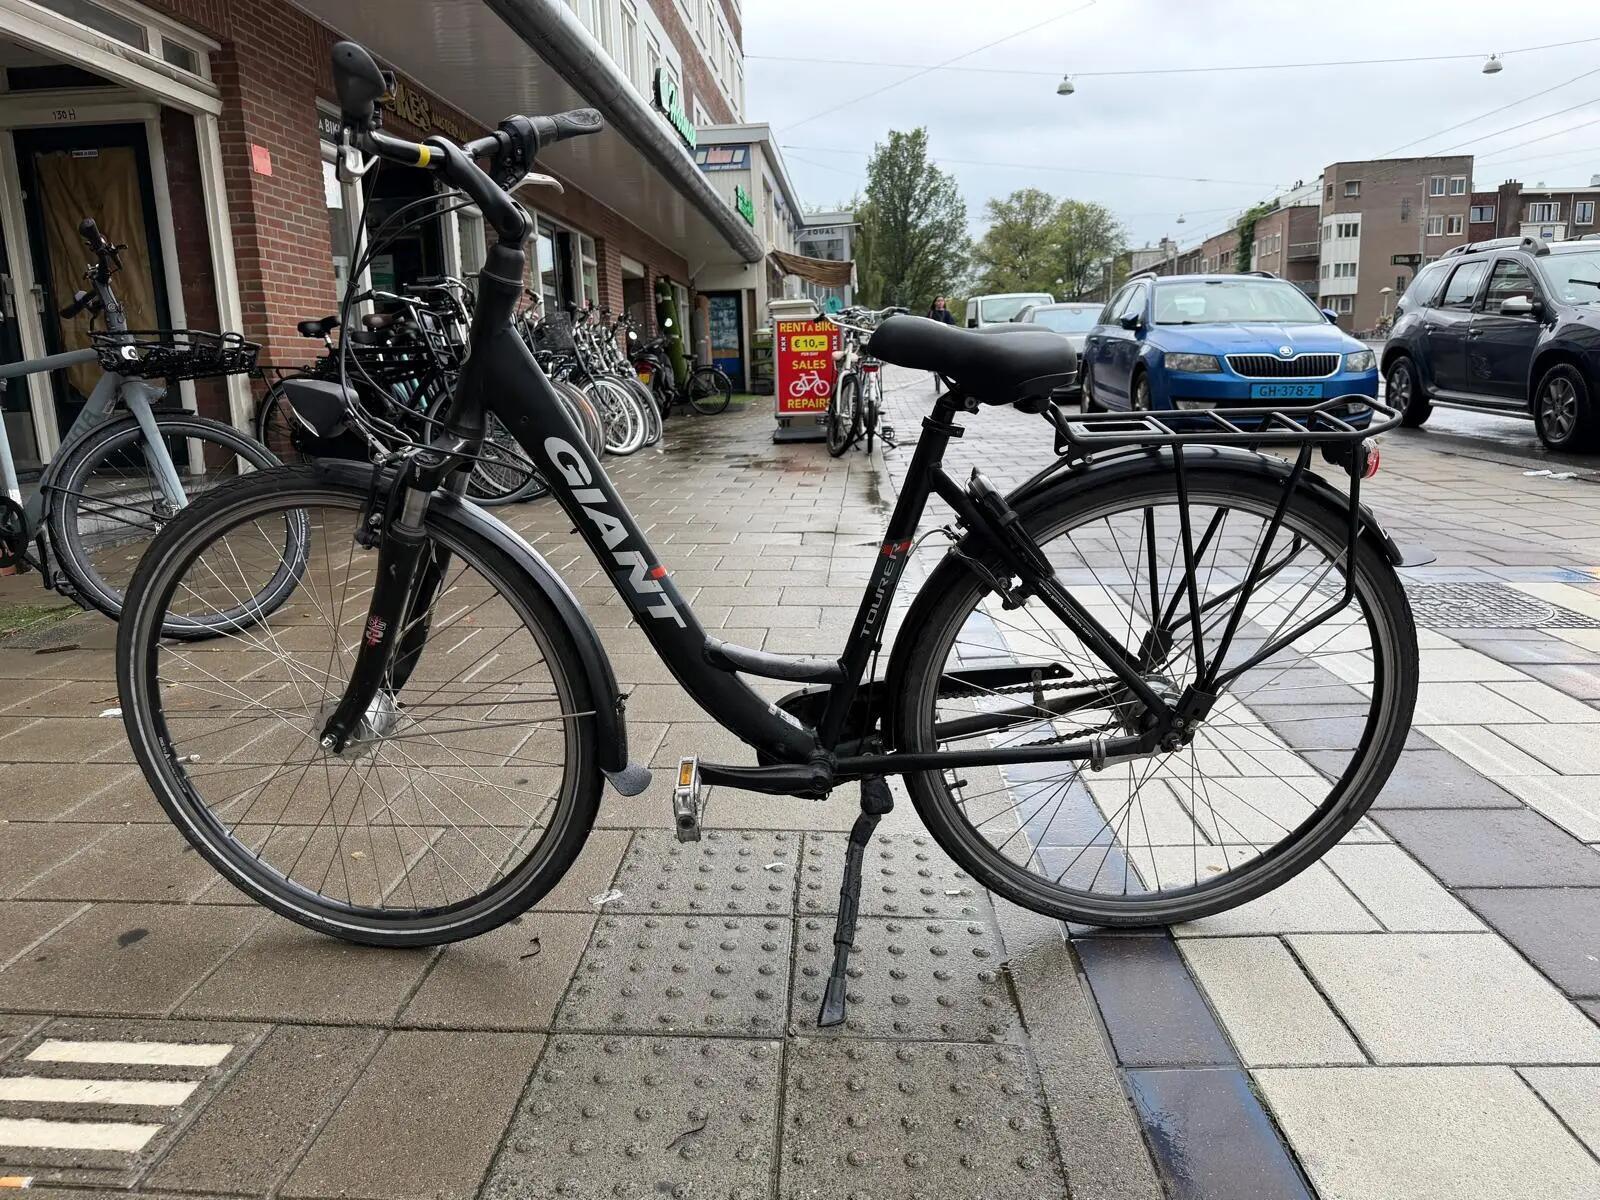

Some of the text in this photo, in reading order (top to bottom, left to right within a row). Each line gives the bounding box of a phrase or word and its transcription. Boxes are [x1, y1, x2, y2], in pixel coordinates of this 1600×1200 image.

[807, 228, 835, 236] EQUAL
[780, 322, 807, 333] RENT
[815, 321, 838, 332] BIKE
[792, 360, 827, 370] SALES
[1260, 385, 1316, 397] GH-378-Z
[544, 436, 688, 629] GIANT
[860, 543, 898, 639] TOURER
